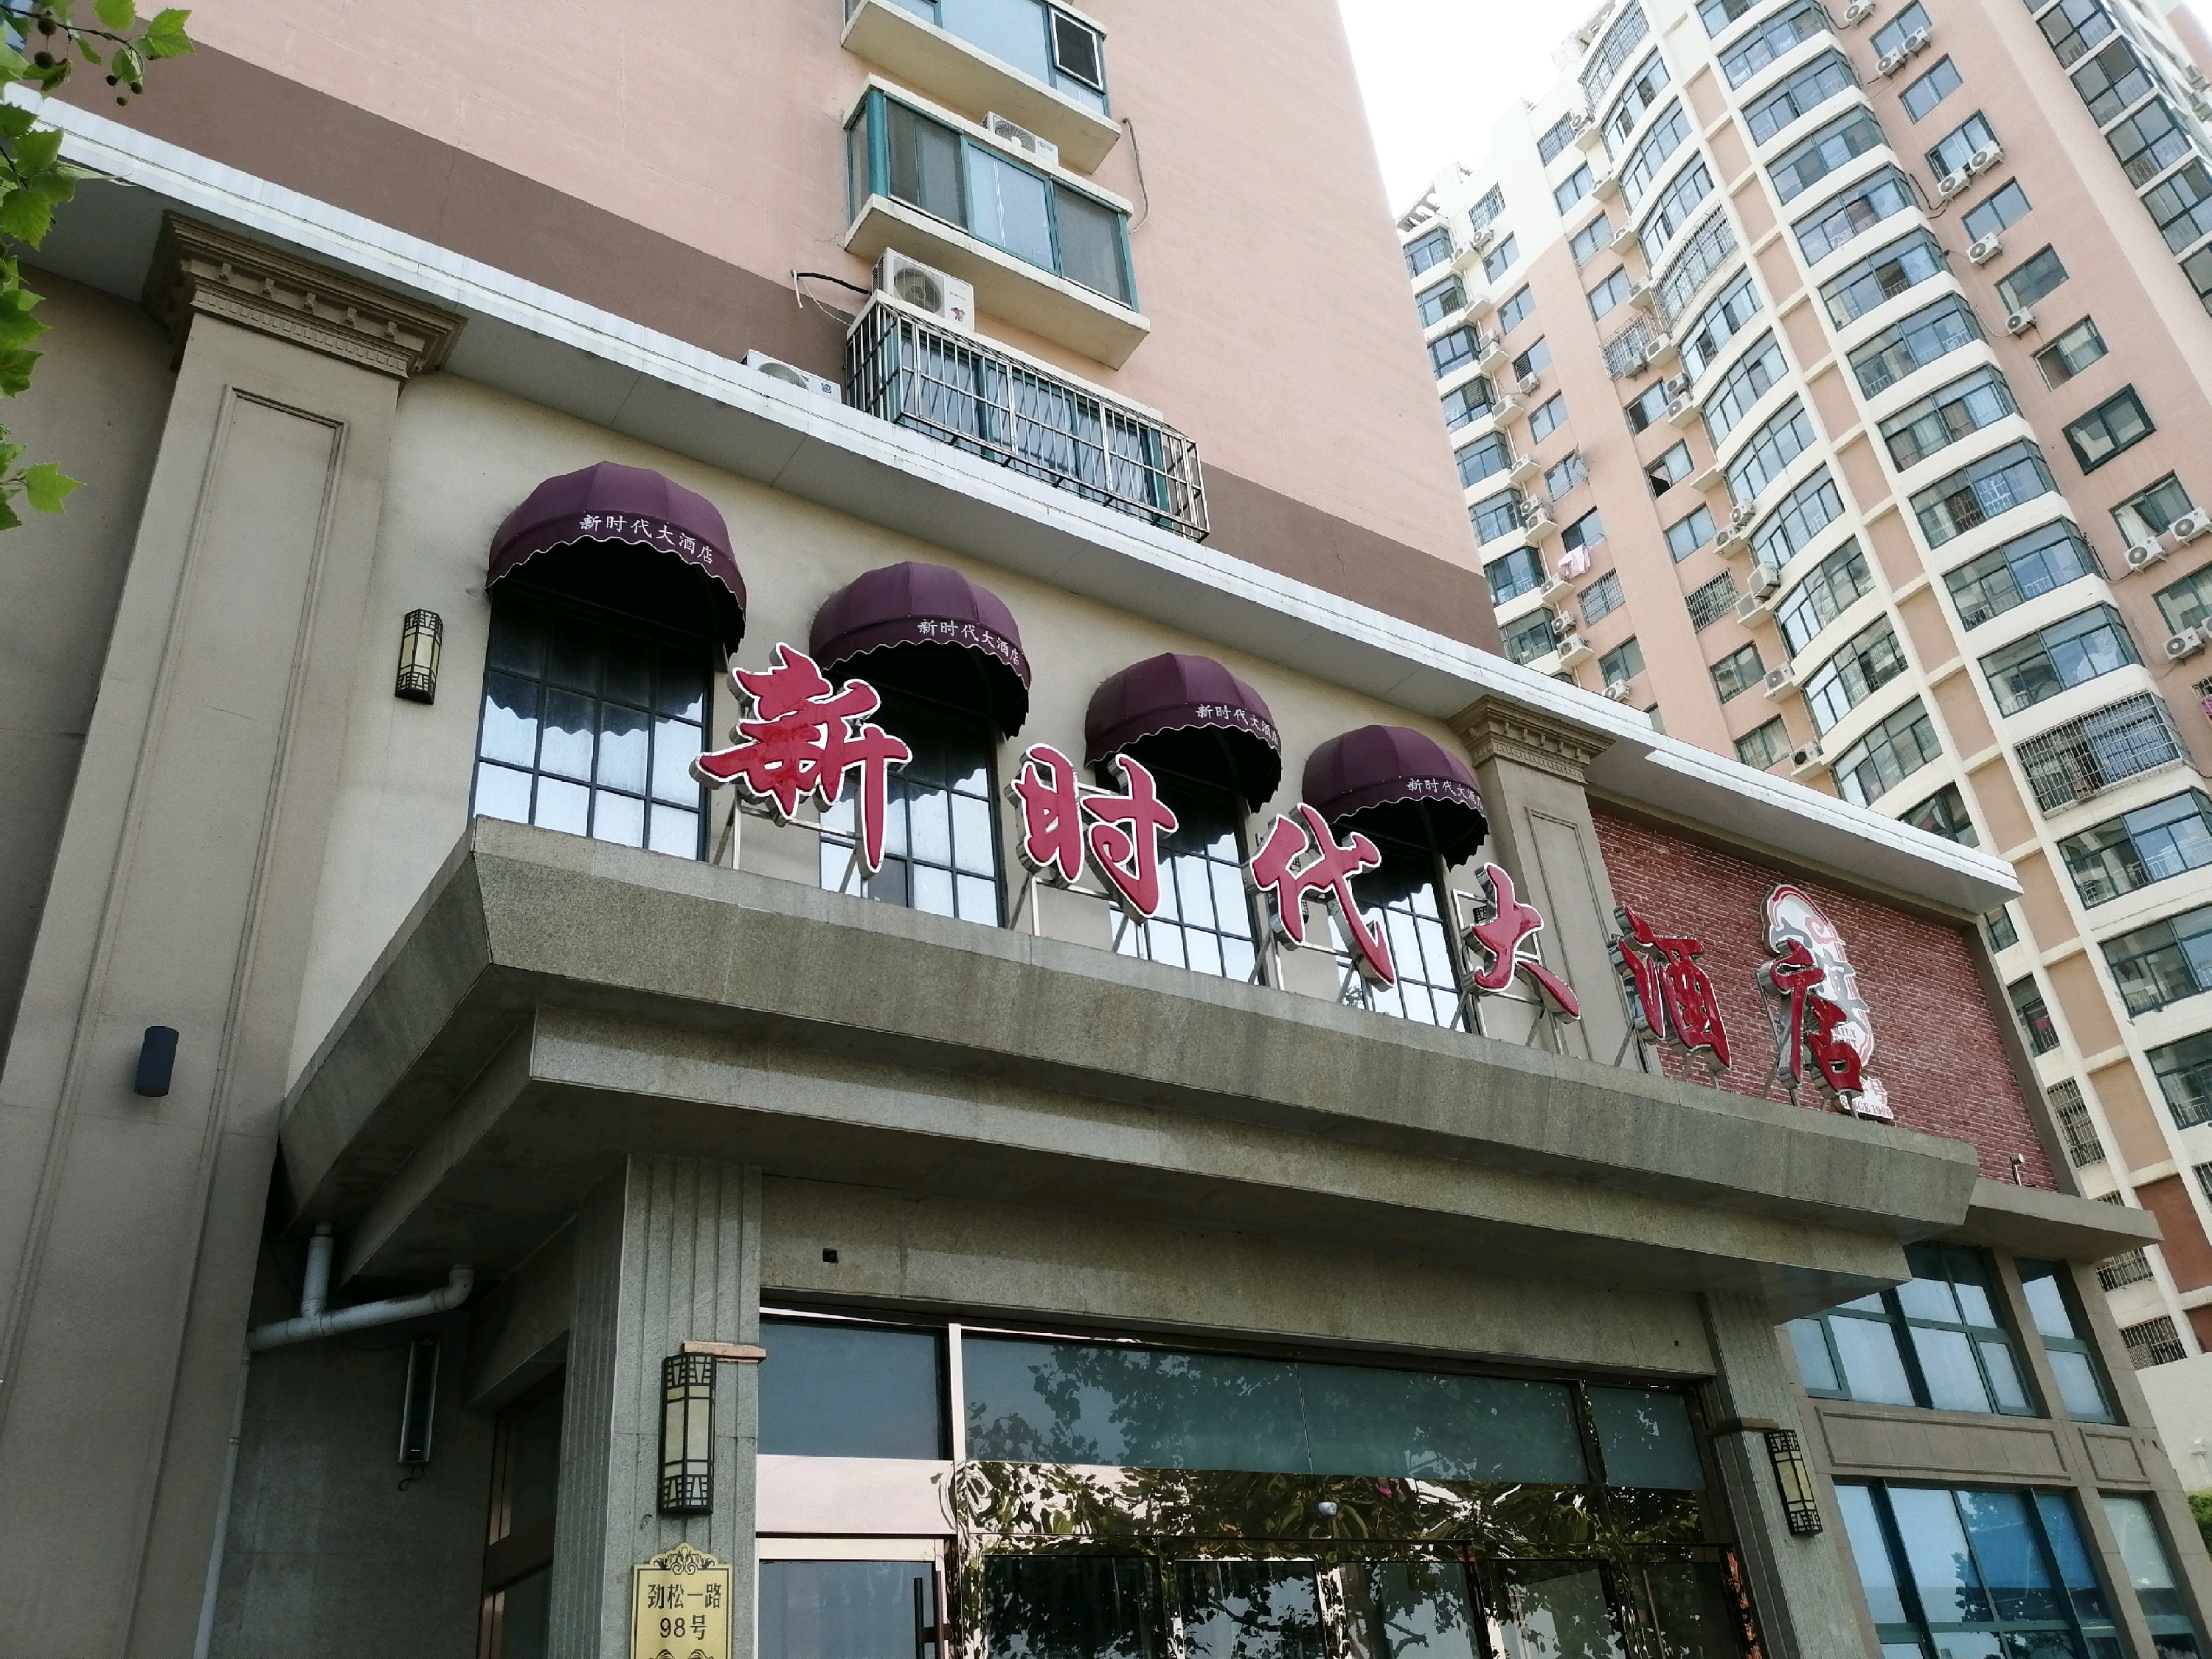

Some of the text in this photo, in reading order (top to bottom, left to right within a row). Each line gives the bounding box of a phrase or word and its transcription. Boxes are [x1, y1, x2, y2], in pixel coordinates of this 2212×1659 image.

[579, 514, 713, 564] 新时代大酒店
[917, 619, 1020, 665] 新时代大酒店
[1195, 704, 1279, 746] 新时代大酒店
[693, 642, 1865, 1095] 新时代大酒店
[648, 1583, 722, 1610] 劲松一路
[659, 1614, 707, 1641] 98号
